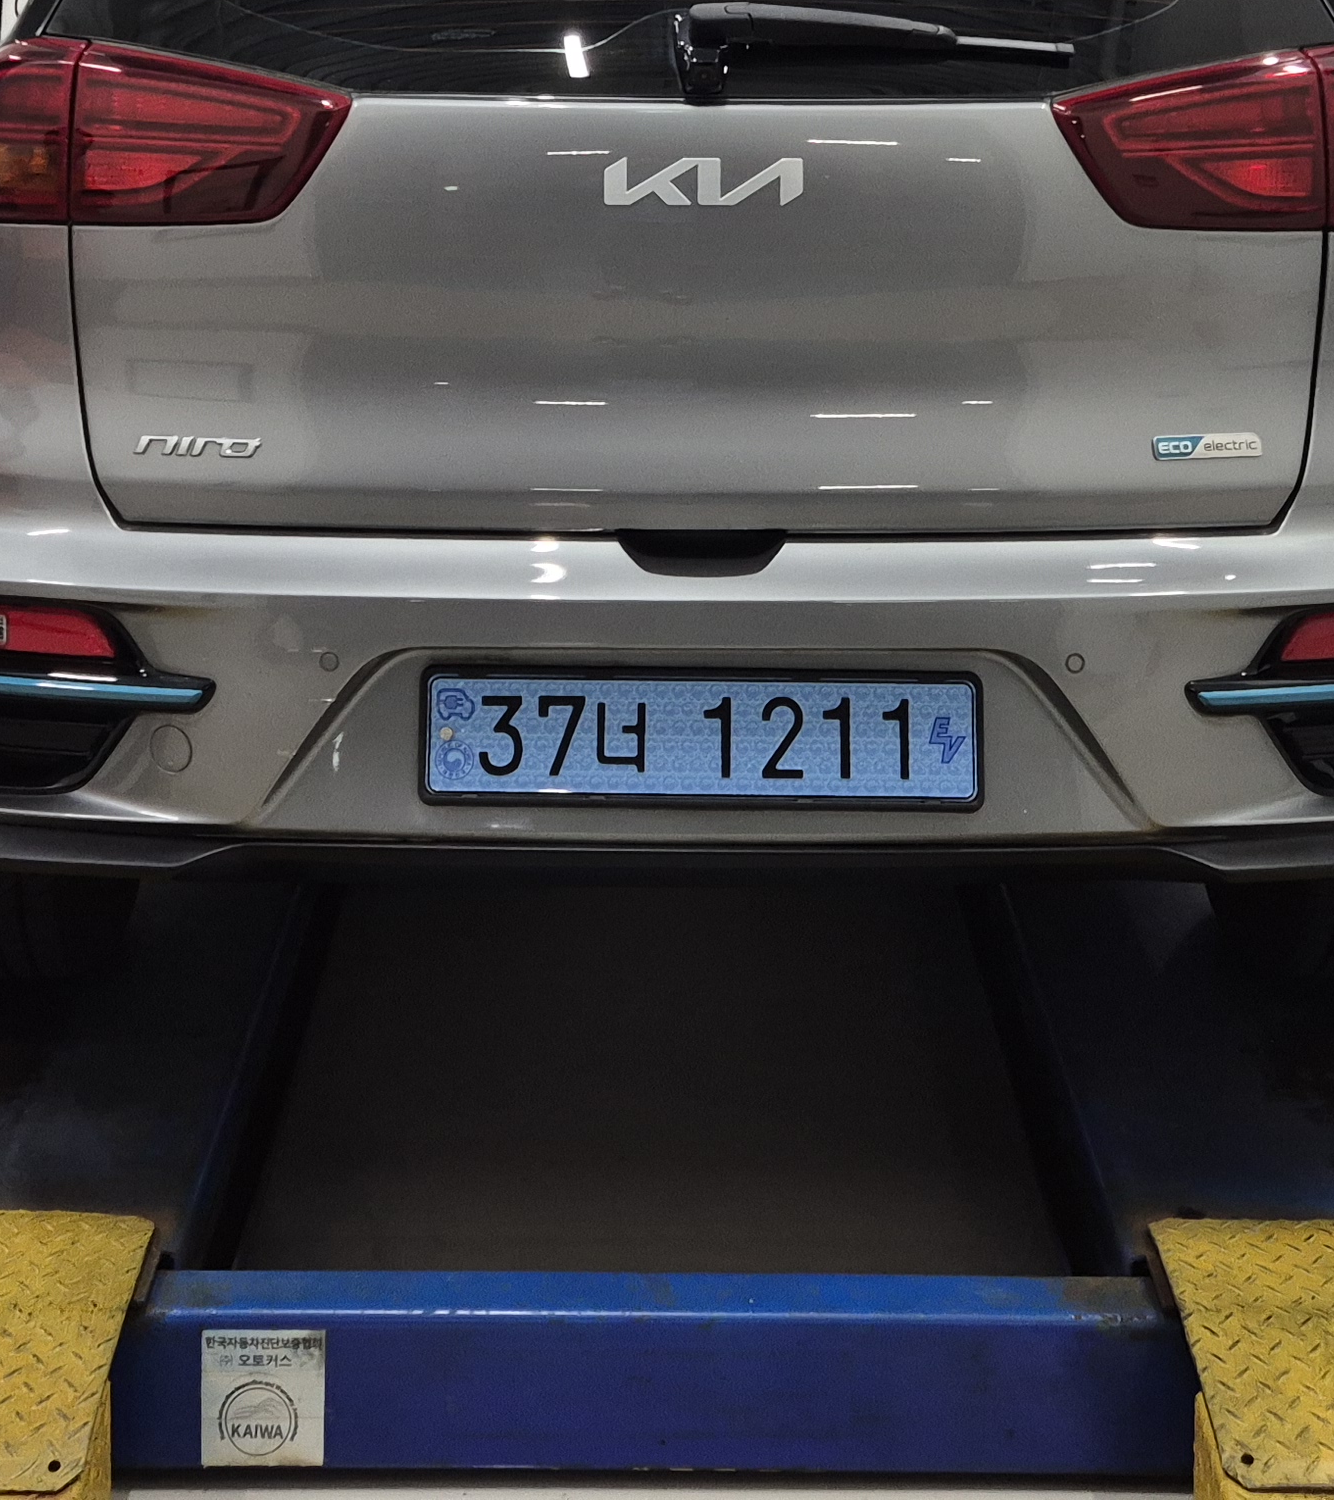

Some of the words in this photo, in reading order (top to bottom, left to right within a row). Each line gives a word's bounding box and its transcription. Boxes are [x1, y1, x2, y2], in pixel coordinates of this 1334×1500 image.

[603, 156, 804, 206] KIA
[1157, 440, 1193, 454] ECO
[1203, 439, 1257, 452] electric
[478, 694, 647, 777] 37너
[703, 696, 911, 780] 1211
[928, 716, 967, 764] EV
[238, 1354, 292, 1368] 오토커스
[231, 1423, 284, 1440] KAIWA
